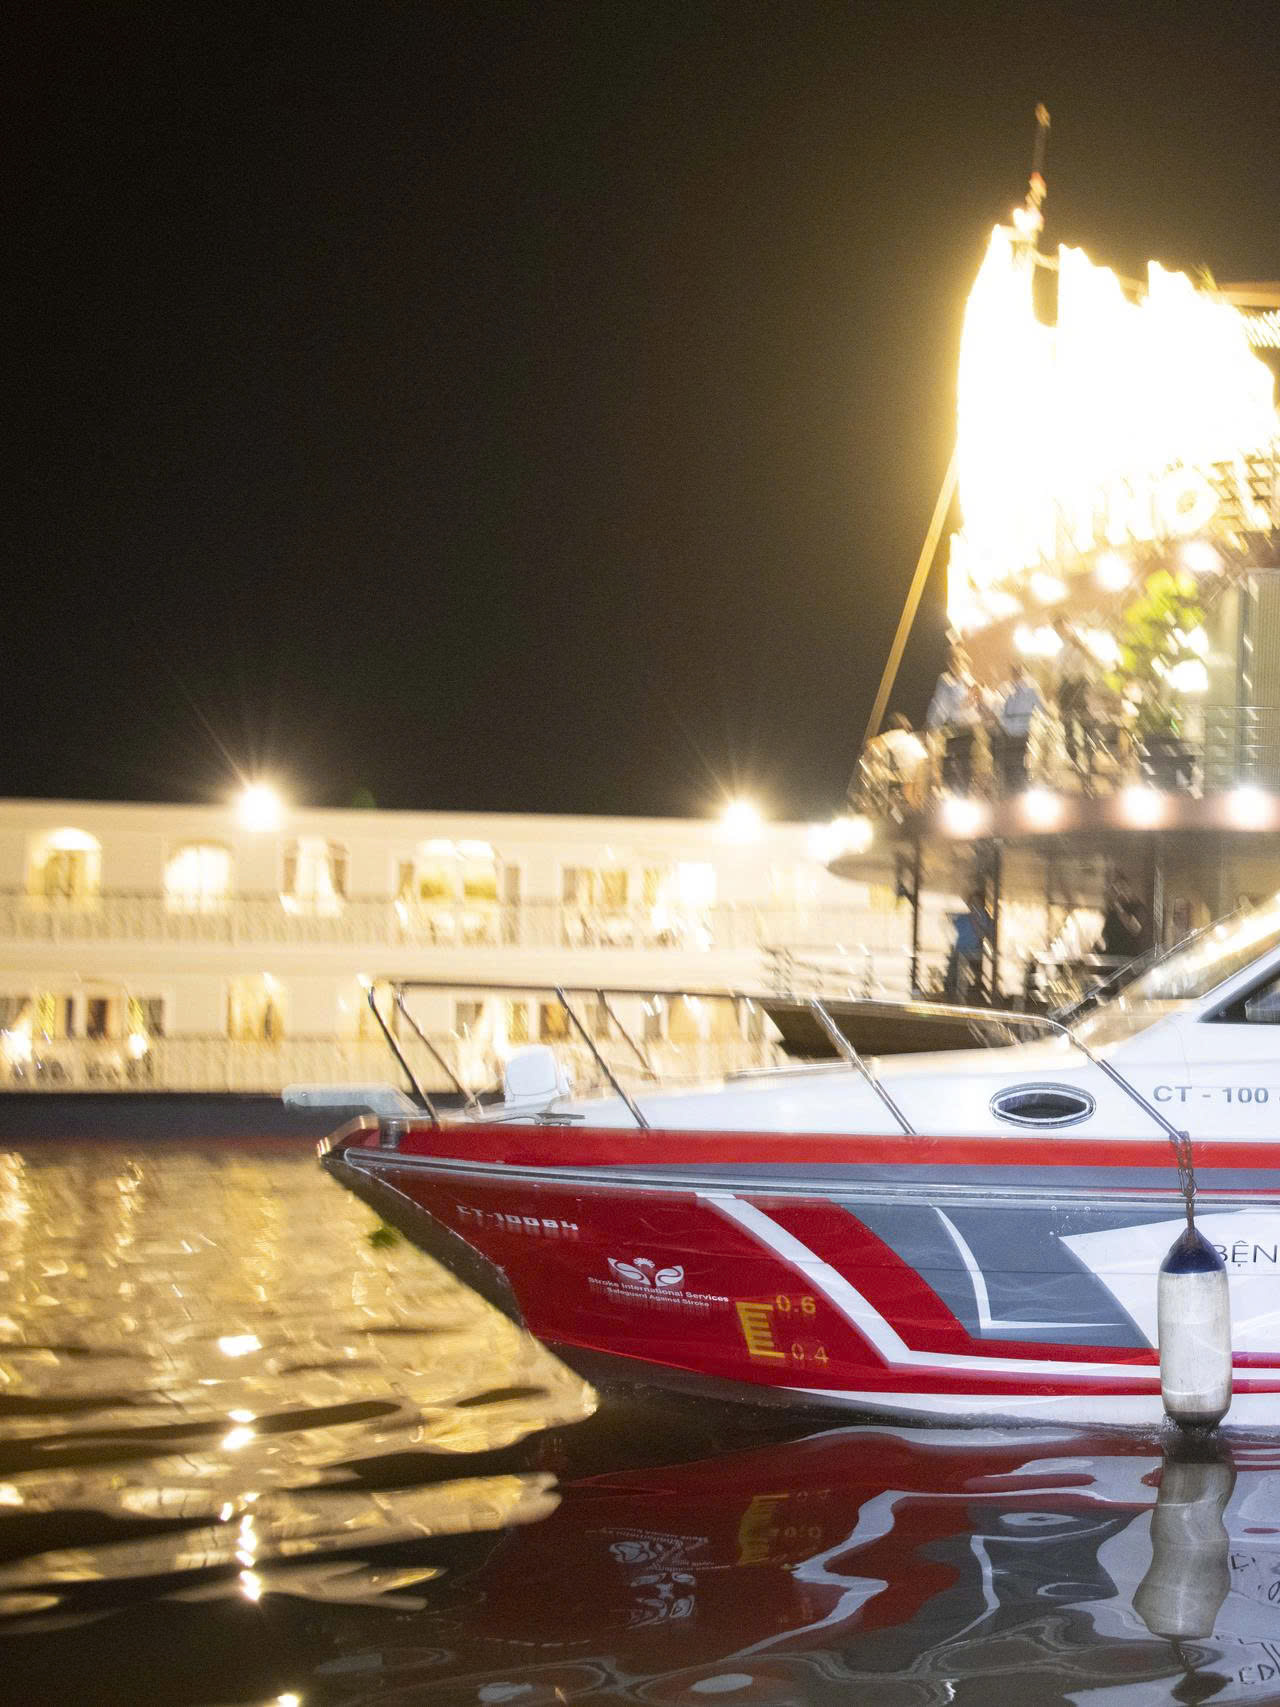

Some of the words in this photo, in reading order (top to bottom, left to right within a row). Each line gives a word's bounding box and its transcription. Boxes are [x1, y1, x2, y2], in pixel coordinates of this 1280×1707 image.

[1153, 1086, 1192, 1103] CT
[1223, 1087, 1268, 1104] 100
[456, 1205, 579, 1231] CT-10084
[621, 1283, 683, 1298] International
[685, 1291, 729, 1303] Services
[776, 1294, 817, 1315] 0.6
